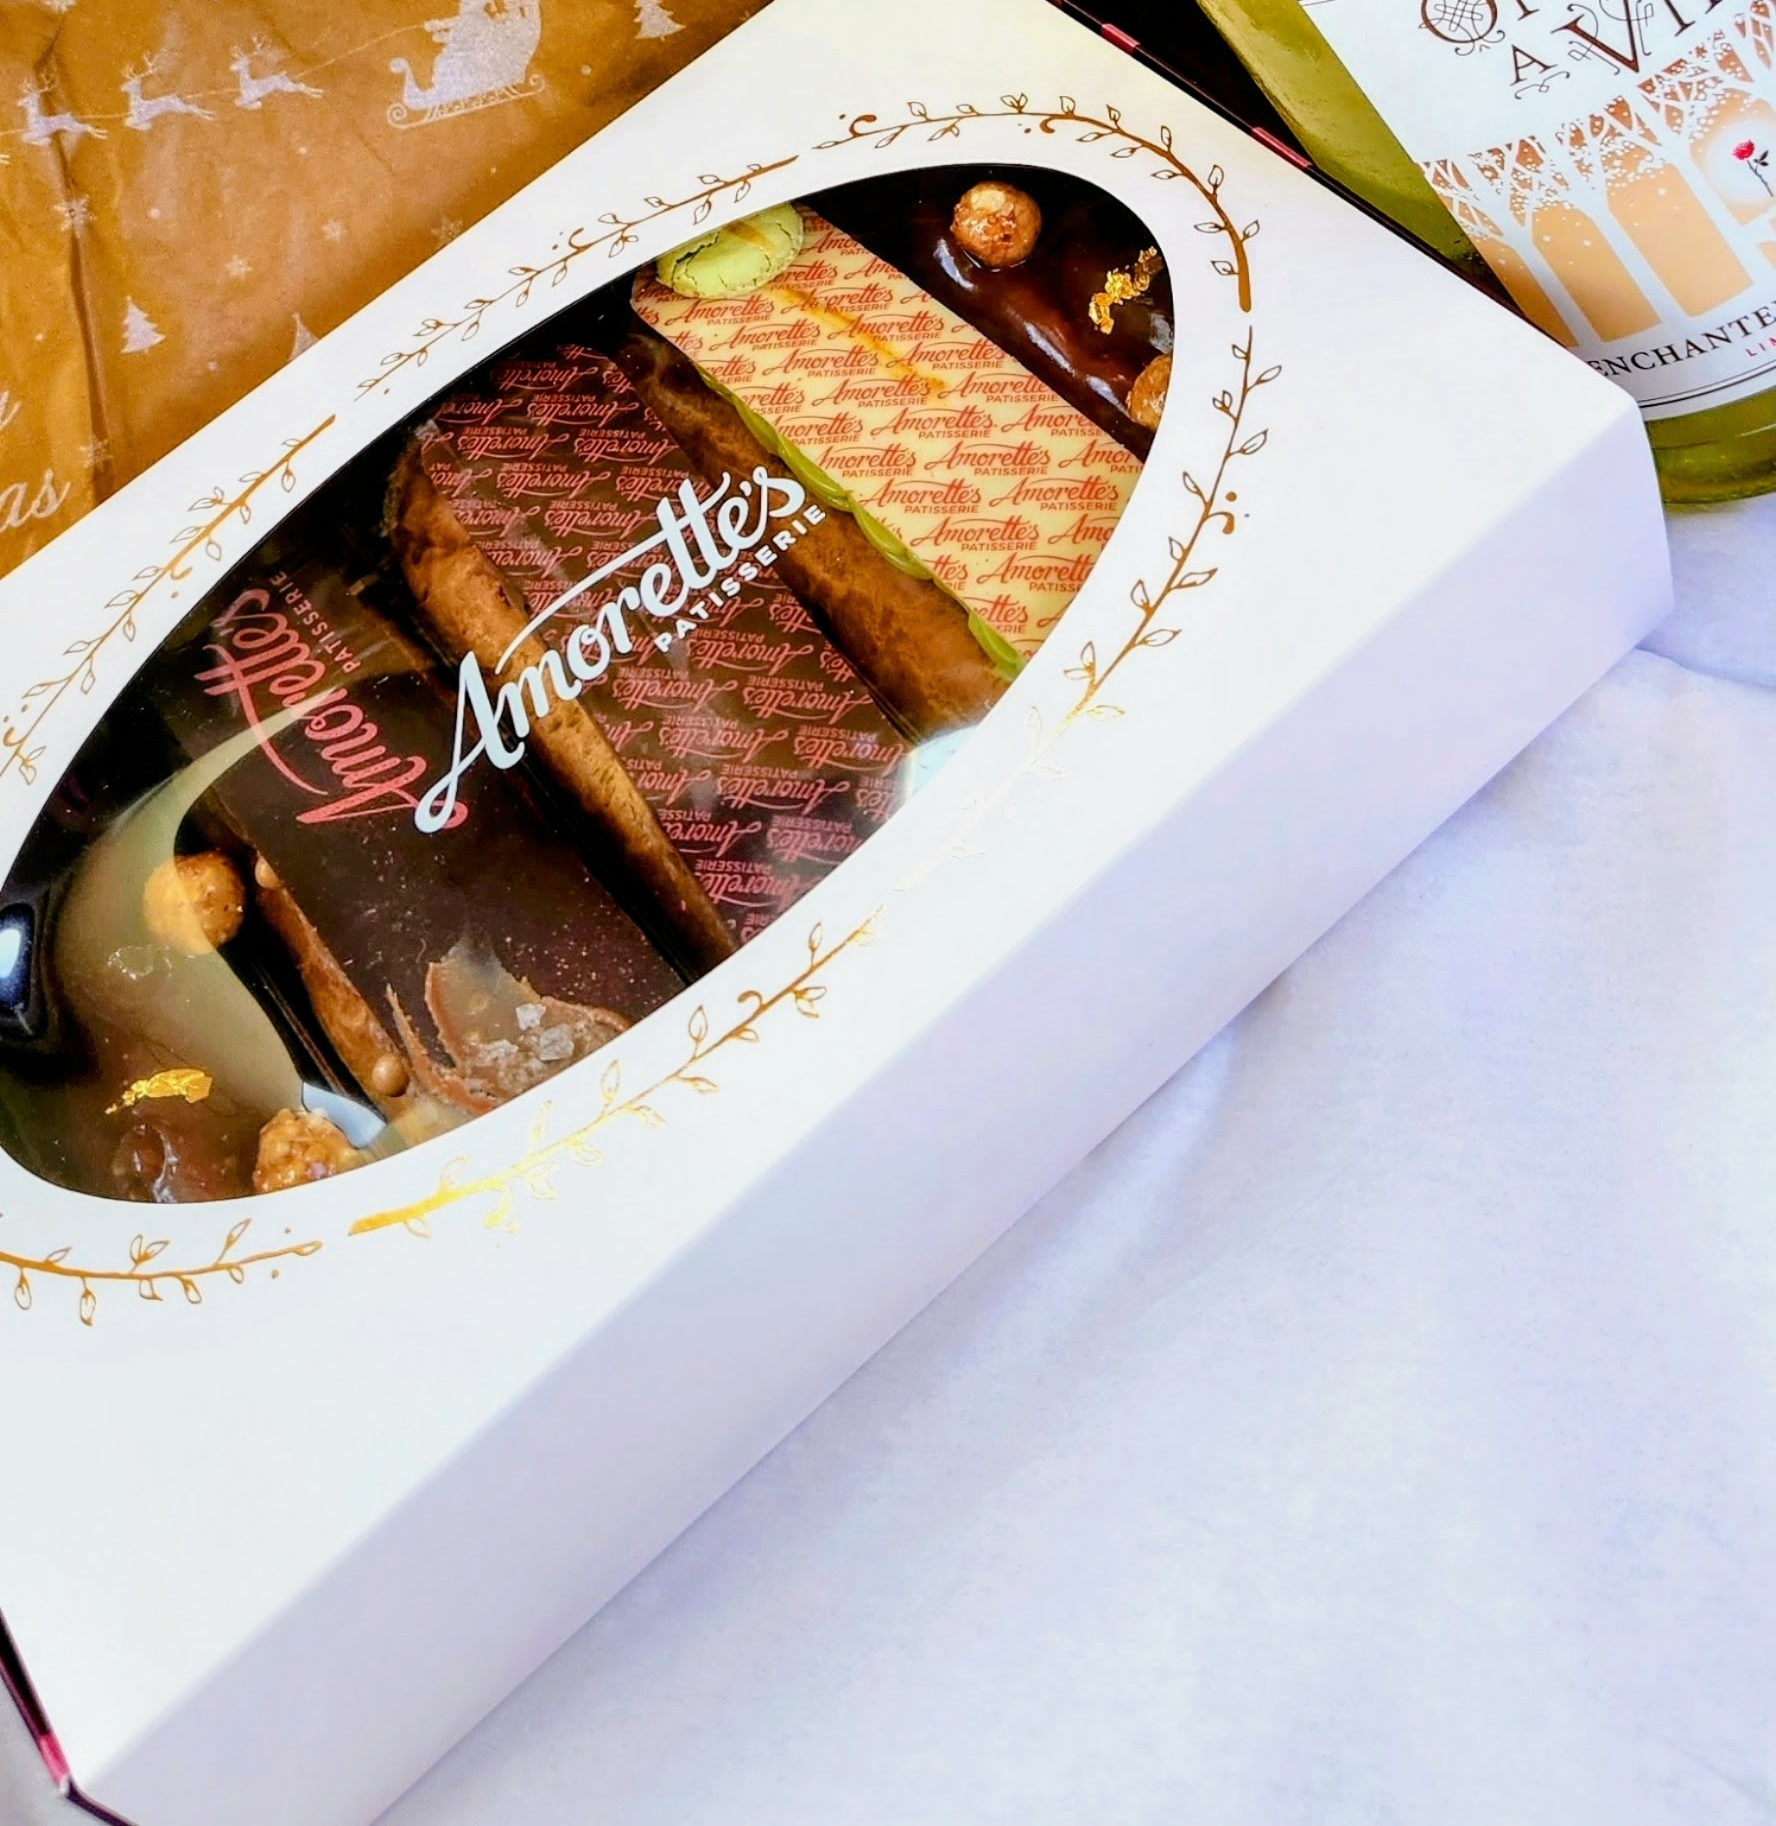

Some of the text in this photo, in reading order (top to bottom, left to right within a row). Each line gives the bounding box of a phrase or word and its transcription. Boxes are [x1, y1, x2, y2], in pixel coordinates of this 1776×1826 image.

[1510, 42, 1556, 85] A
[665, 295, 774, 326] Amorette's
[707, 314, 771, 325] PATISSERIE
[827, 310, 944, 339] Amorette's
[710, 319, 820, 350] Amorette's
[1586, 300, 1776, 377] ENCHANTE
[763, 345, 879, 376] Amorette's
[886, 340, 1004, 369] Amorette's
[932, 360, 1004, 371] PATISSERIE
[808, 368, 875, 378] PATISSERIE
[938, 371, 1048, 400] Amorett
[811, 373, 931, 407] Amorette's
[857, 397, 928, 408] PATISSERIE
[986, 394, 1059, 403] PATISSERIE
[527, 399, 640, 427] Amorette's
[774, 411, 863, 438] morette's
[870, 405, 994, 436] Amorette's
[457, 431, 570, 460] Amorette's
[579, 428, 646, 439] PATISSERIE
[918, 430, 991, 439] PATISSERIE
[1051, 428, 1102, 437] PATISSE
[574, 437, 680, 465] Amorette's
[817, 442, 916, 470] Amorette's
[924, 440, 1050, 470] Amorette's
[497, 470, 611, 499] Amorette's
[842, 467, 913, 478] PATISSERIE
[974, 466, 1048, 476] PATISSERIE
[549, 500, 617, 511] PATISSERIE
[860, 477, 981, 507] Amorette's
[989, 475, 1119, 507] Amorette's
[904, 505, 980, 514] PATISSERIE
[1040, 501, 1117, 511] PATISSERIE
[545, 508, 657, 539] Amorette's
[910, 515, 1039, 547] Amorette's
[961, 541, 1037, 552] PATISSERIE
[654, 504, 826, 653] PATISSERIE
[976, 551, 1095, 584] Amorett
[269, 571, 361, 673] PATISSERIE
[413, 466, 805, 833] Amorette's
[687, 639, 813, 675] Amorette's
[613, 679, 738, 712] Amorette's
[749, 675, 824, 690] PATISSERIE
[194, 589, 469, 829] Amorette's
[742, 686, 873, 724] Amorette's
[659, 726, 789, 763] Amorette's
[798, 724, 877, 741] PATISSERIE
[721, 764, 798, 778] PATISSERIE
[717, 778, 850, 814] Amorette's
[660, 809, 711, 821] PATISSE
